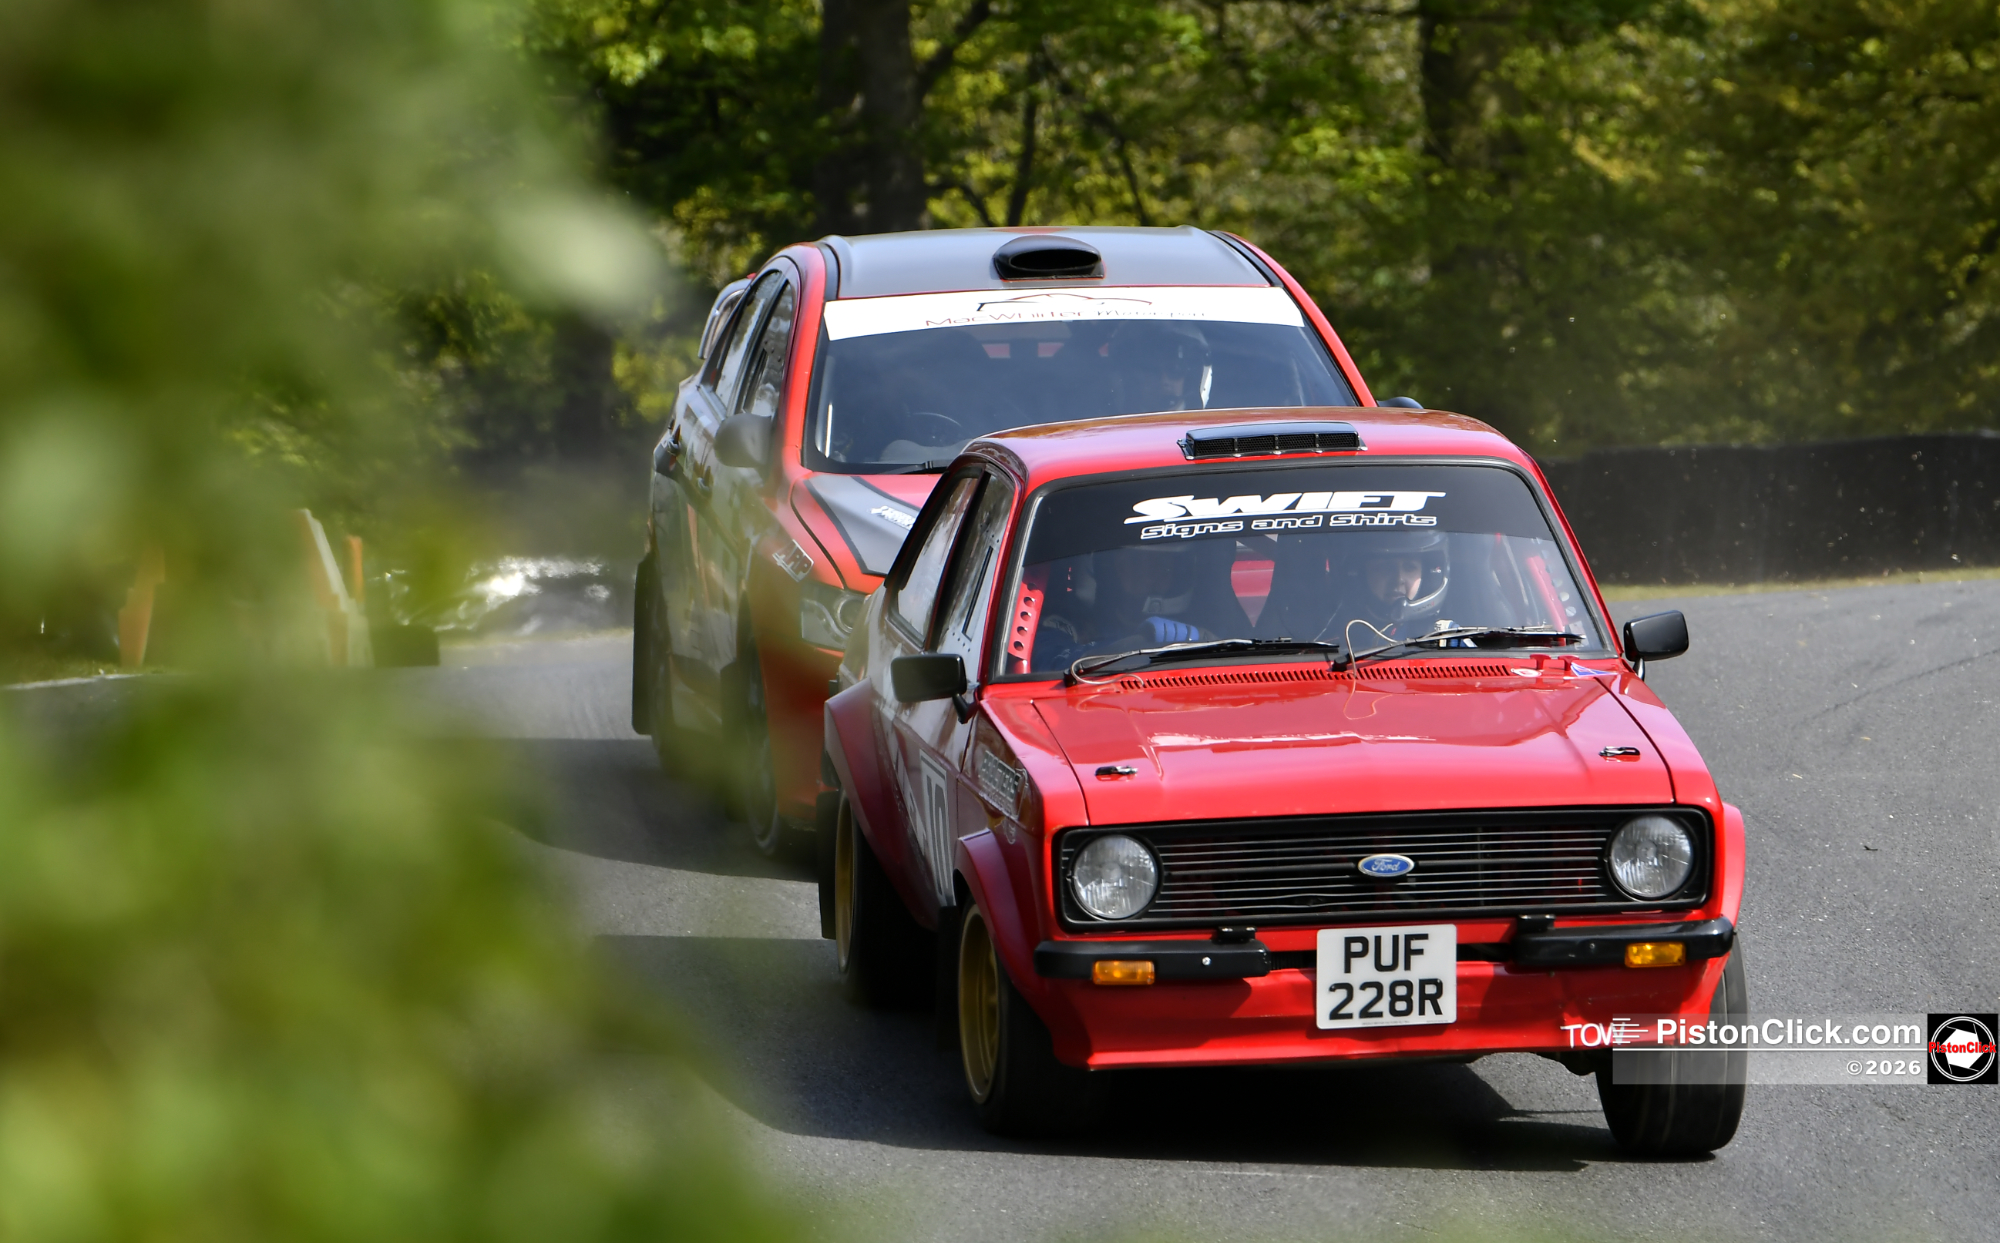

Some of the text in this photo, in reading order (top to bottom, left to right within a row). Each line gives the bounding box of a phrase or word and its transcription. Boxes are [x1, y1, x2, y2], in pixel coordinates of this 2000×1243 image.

[1124, 491, 1447, 525] SWIFT
[1251, 514, 1324, 530] and
[773, 540, 815, 578] ARP
[1371, 858, 1400, 872] Ford
[1344, 933, 1429, 974] PUF
[1329, 978, 1443, 1021] 228R
[1560, 1022, 1627, 1048] TOW
